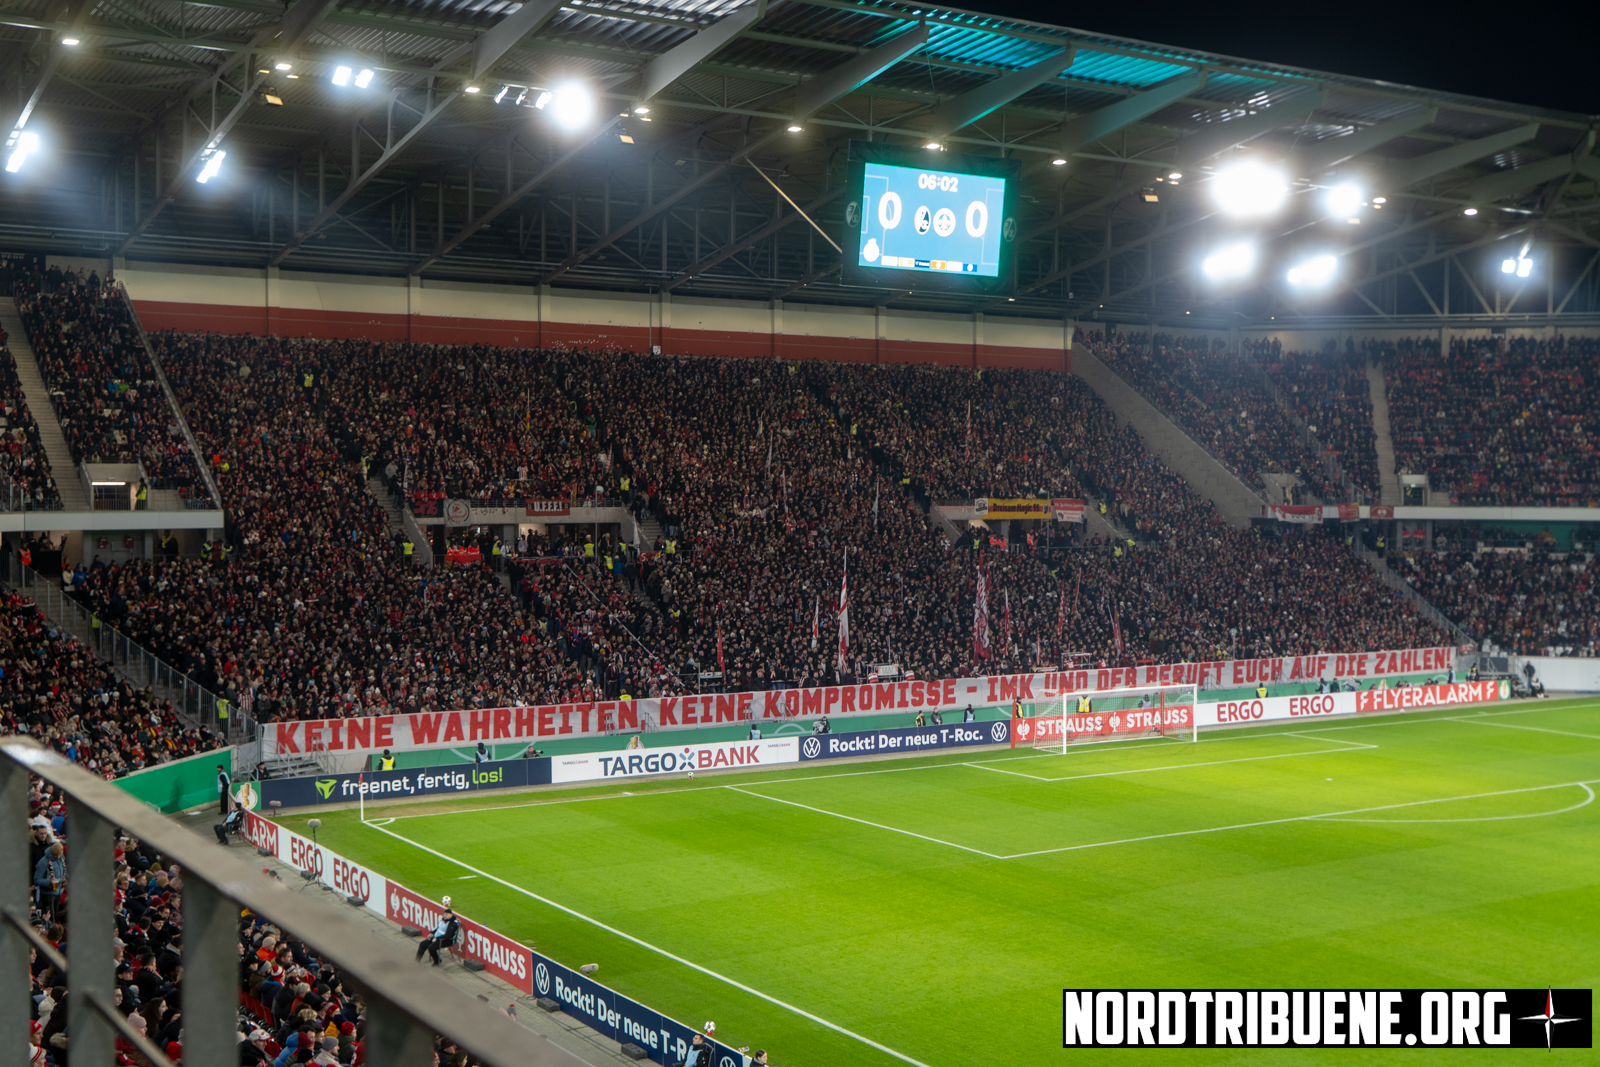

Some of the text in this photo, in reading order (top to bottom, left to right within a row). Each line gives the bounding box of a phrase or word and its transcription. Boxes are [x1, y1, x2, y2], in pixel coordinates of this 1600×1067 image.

[918, 173, 959, 193] 06:02
[878, 191, 902, 230] 0
[965, 201, 988, 238] 0
[276, 716, 394, 755] KEINE
[659, 693, 754, 727] KEINE
[763, 678, 957, 719] KOMPROMISSE
[987, 675, 1035, 702] IMK
[1044, 671, 1089, 698] UND
[1233, 659, 1283, 684] EUCH
[1290, 656, 1329, 680] AUF
[1335, 654, 1368, 677] DIE
[1374, 648, 1451, 675] ZAHLEN!
[1289, 695, 1335, 716] ERGO
[1373, 682, 1483, 710] FLYERALARM
[1127, 708, 1188, 728] STRAUSS
[1217, 700, 1263, 723] ERGO
[1037, 715, 1103, 737] STRAUSS
[829, 728, 983, 753] Rockt! Der neue T-Roc.
[341, 767, 503, 796] freenet, fertig, los!
[291, 836, 323, 878] ERGO
[333, 857, 370, 903] ERGO
[467, 929, 526, 980] STRAUSS
[556, 975, 595, 1017] Rockt!
[597, 997, 621, 1029] Der
[624, 1015, 658, 1049] neue
